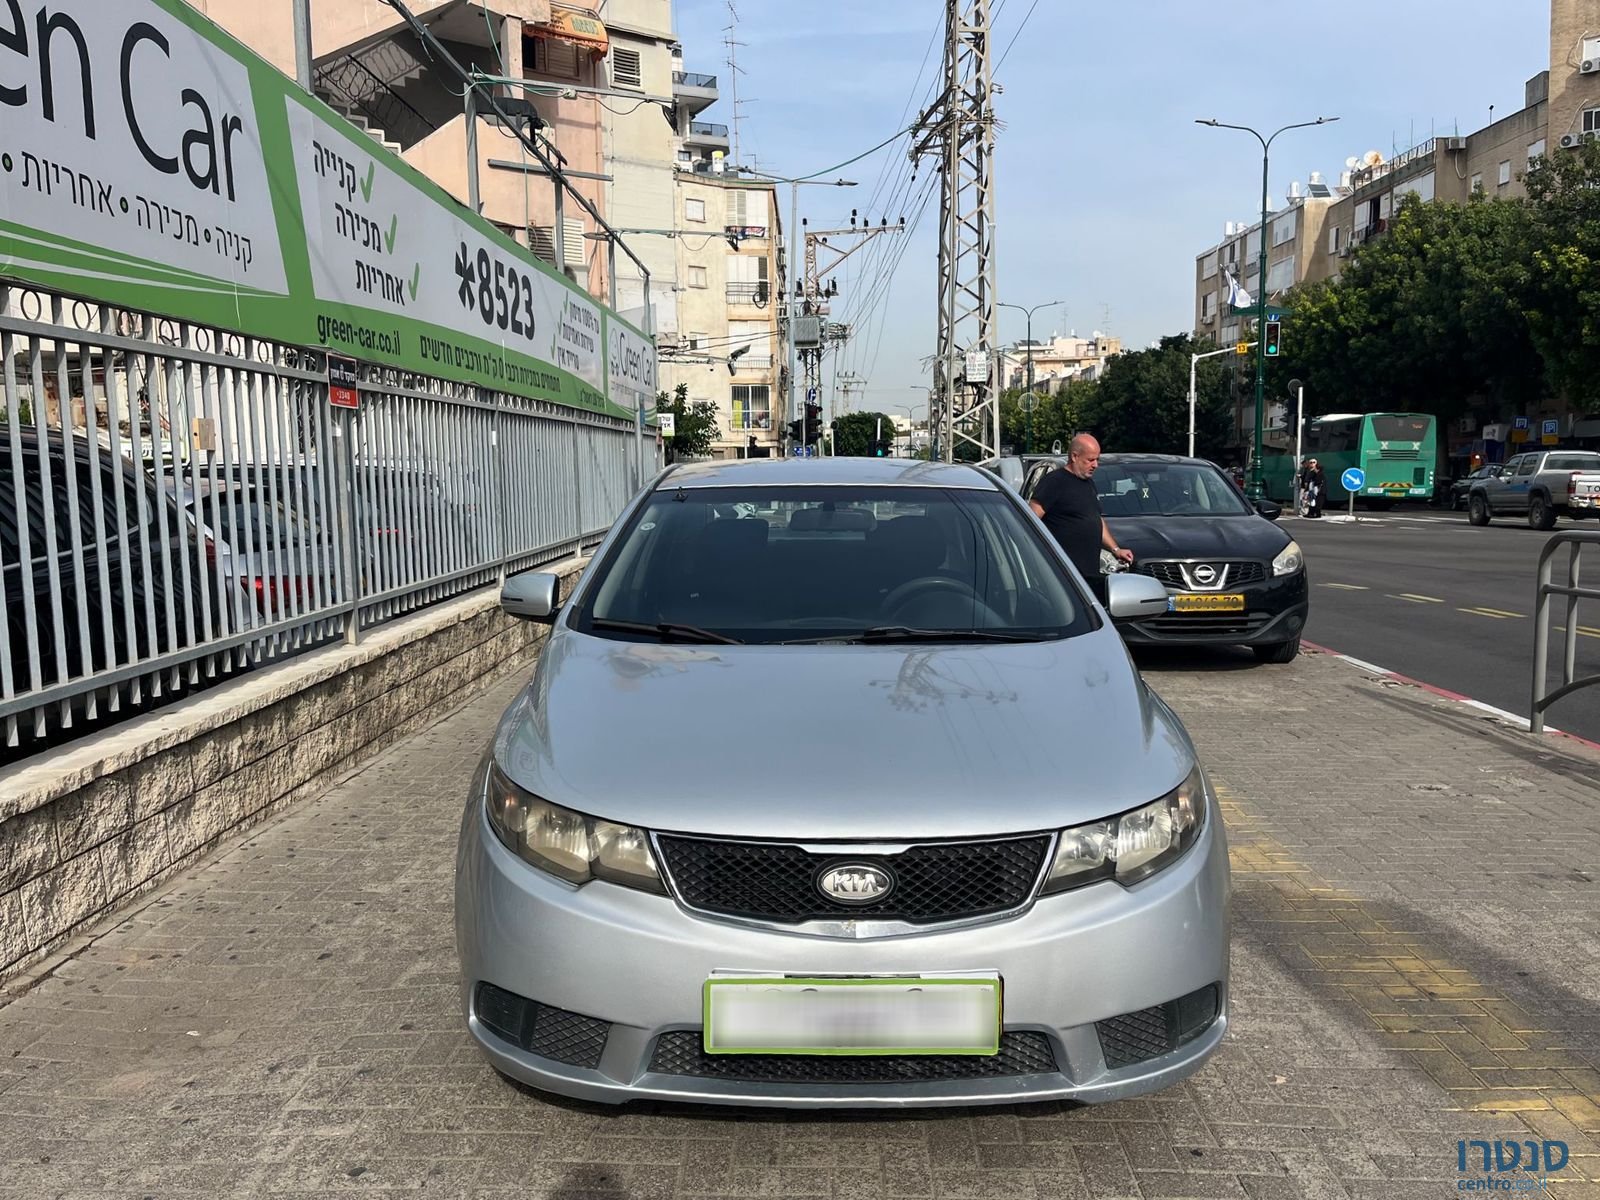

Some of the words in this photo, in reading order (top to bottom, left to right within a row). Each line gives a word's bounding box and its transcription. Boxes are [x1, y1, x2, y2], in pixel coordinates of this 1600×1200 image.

[120, 22, 242, 202] Car
[22, 151, 114, 217] אחריות
[313, 140, 356, 201] קנייה
[136, 196, 199, 246] מכירה
[335, 202, 381, 253] מכירה
[216, 227, 252, 271] קניה
[355, 260, 405, 305] אחריות
[317, 314, 401, 356] green-car.co.il
[419, 335, 453, 365] חדשים
[620, 332, 641, 382] Green
[832, 872, 879, 893] KIA
